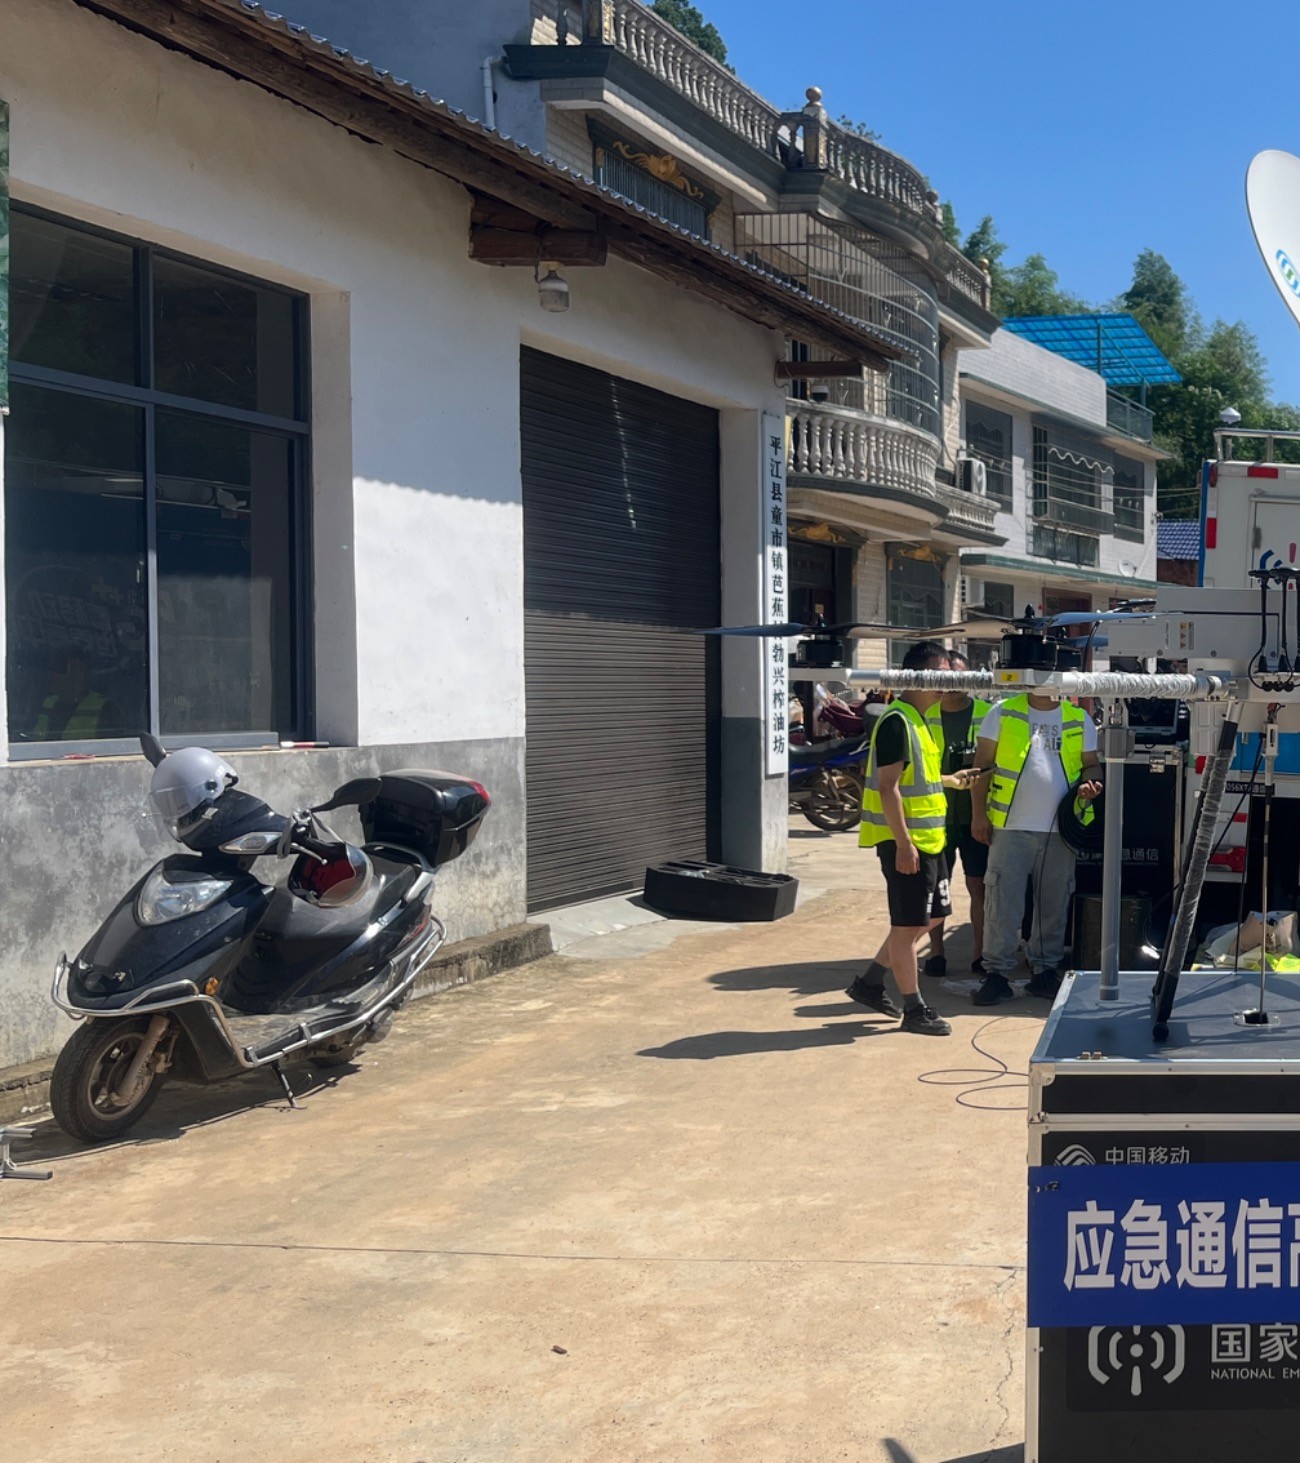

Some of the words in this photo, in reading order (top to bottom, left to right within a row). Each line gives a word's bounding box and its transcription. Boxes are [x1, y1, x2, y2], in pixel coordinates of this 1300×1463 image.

[1105, 1147, 1190, 1165] 中国移动
[1211, 1367, 1275, 1380] NATIONAL
